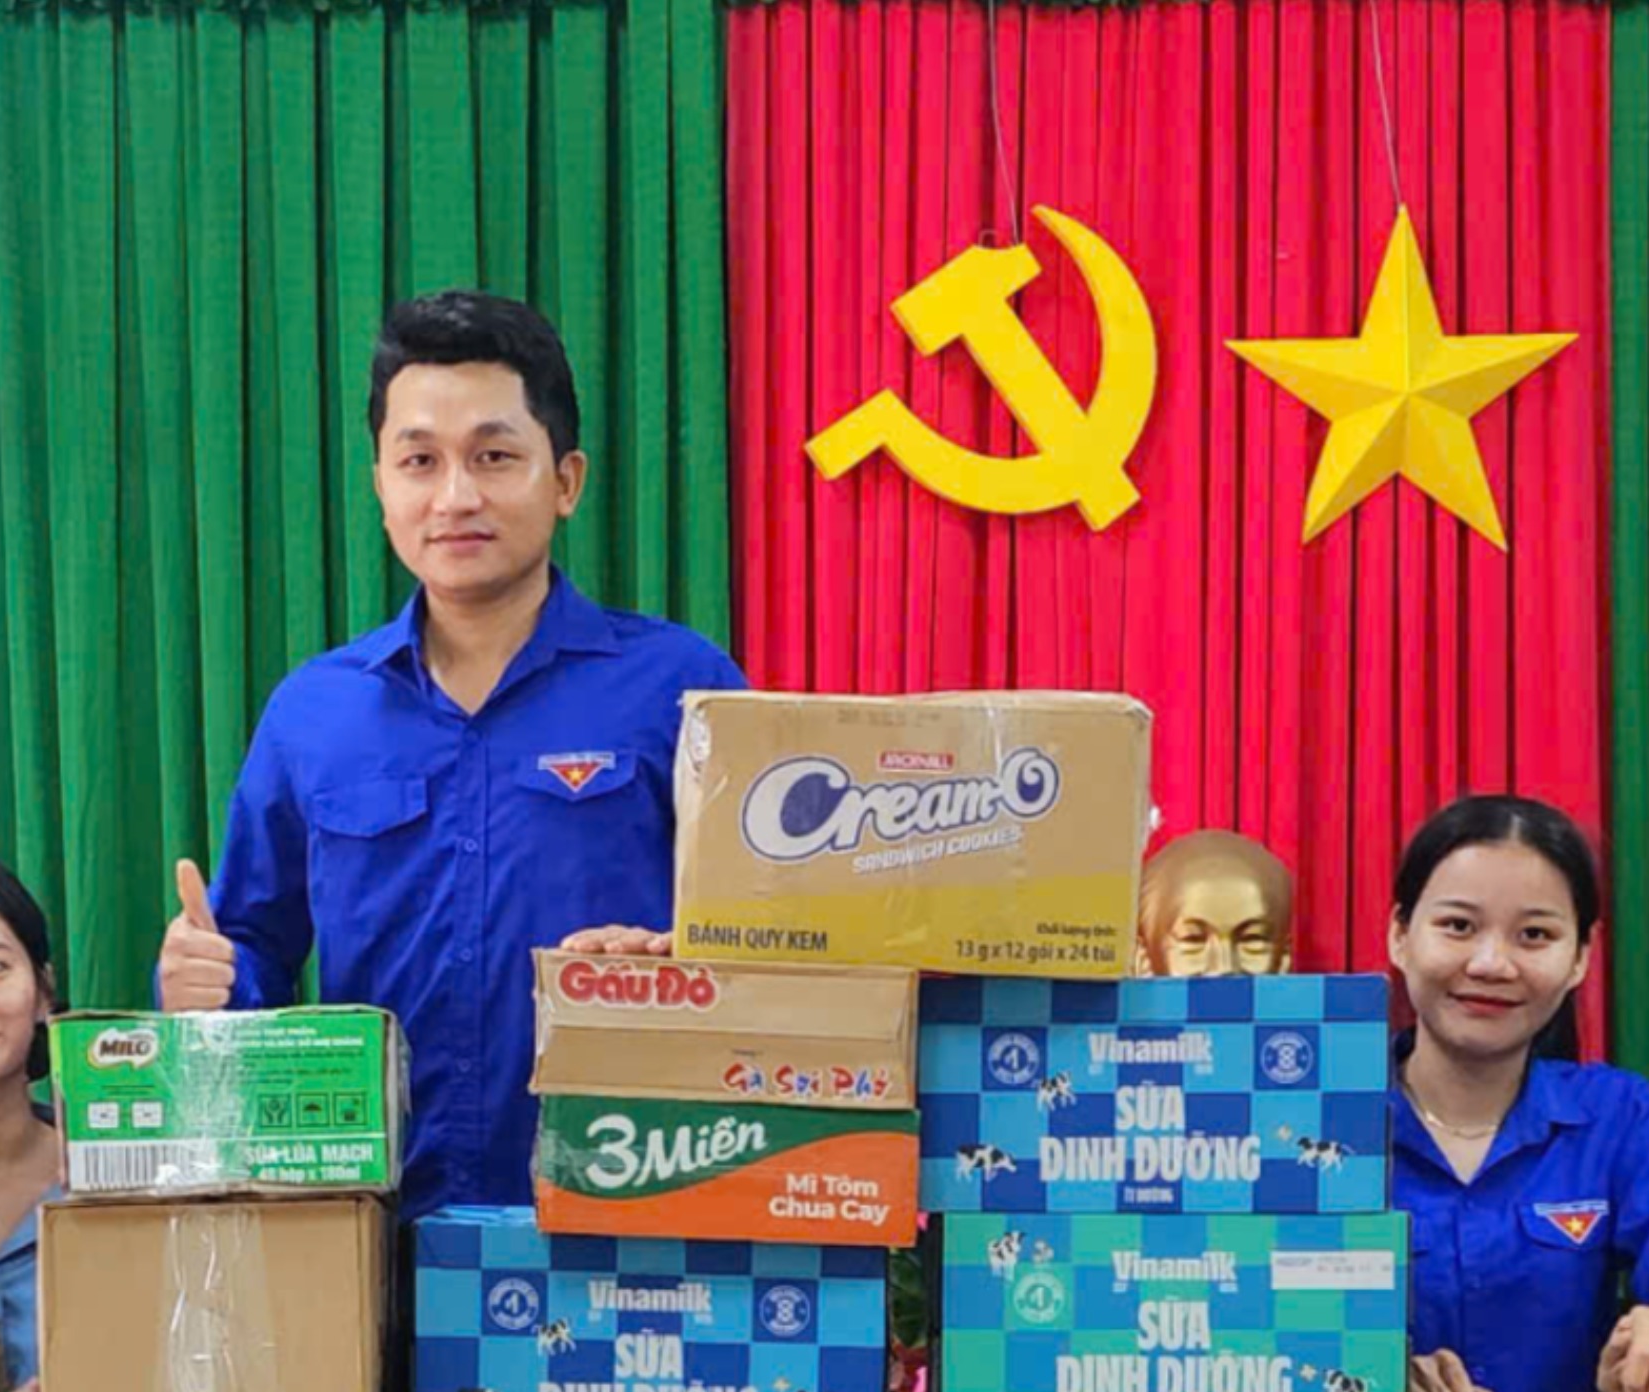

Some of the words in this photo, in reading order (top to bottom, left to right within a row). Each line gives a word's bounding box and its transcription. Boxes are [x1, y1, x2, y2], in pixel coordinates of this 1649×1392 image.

[686, 920, 741, 947] BÁNH
[745, 929, 786, 950] QUY
[787, 931, 828, 952] KEM
[1006, 941, 1025, 960] 12
[1069, 943, 1089, 960] 24
[559, 960, 651, 1004] Gấu
[654, 965, 716, 1008] Đỏ
[99, 1039, 152, 1057] MILO
[1087, 1031, 1214, 1064] Vinamilk
[724, 1062, 764, 1094] Gà
[775, 1064, 821, 1098] Sợi
[831, 1065, 890, 1097] Phở
[1113, 1079, 1186, 1131] SỮA
[585, 1113, 637, 1189] 3
[634, 1116, 768, 1186] Miền
[1038, 1136, 1127, 1183] DINH
[1133, 1131, 1261, 1183] DƯỠNG
[824, 1174, 878, 1198] Tôm
[768, 1196, 836, 1219] Chua
[840, 1200, 890, 1226] Cay
[1111, 1250, 1238, 1282] Vinamilk
[586, 1278, 713, 1313] Vinamilk
[1136, 1294, 1212, 1351] SỮA
[614, 1327, 685, 1380] SỮA
